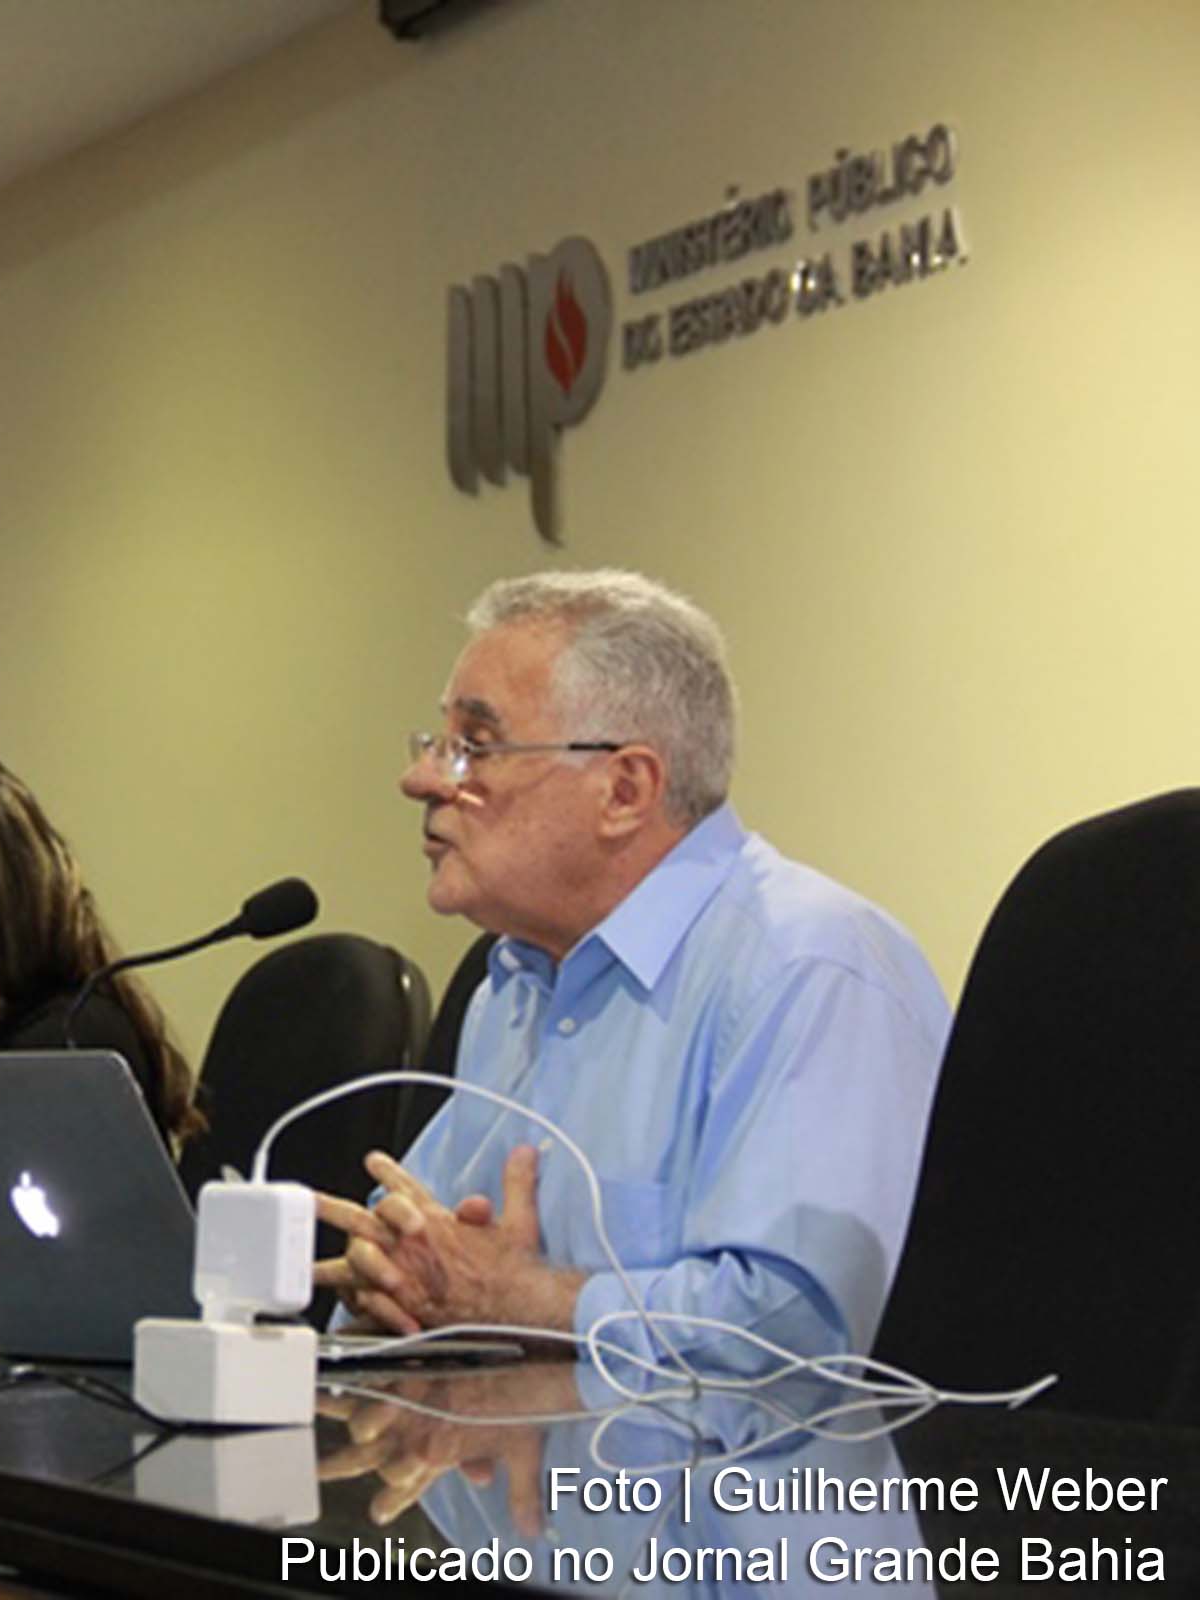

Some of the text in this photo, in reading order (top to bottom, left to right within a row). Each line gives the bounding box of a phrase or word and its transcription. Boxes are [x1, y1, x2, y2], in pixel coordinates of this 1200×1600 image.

[623, 207, 968, 371] DO ESTADO DA BAHIA
[628, 123, 954, 295] MINISTÉRIO PÚBLICO
